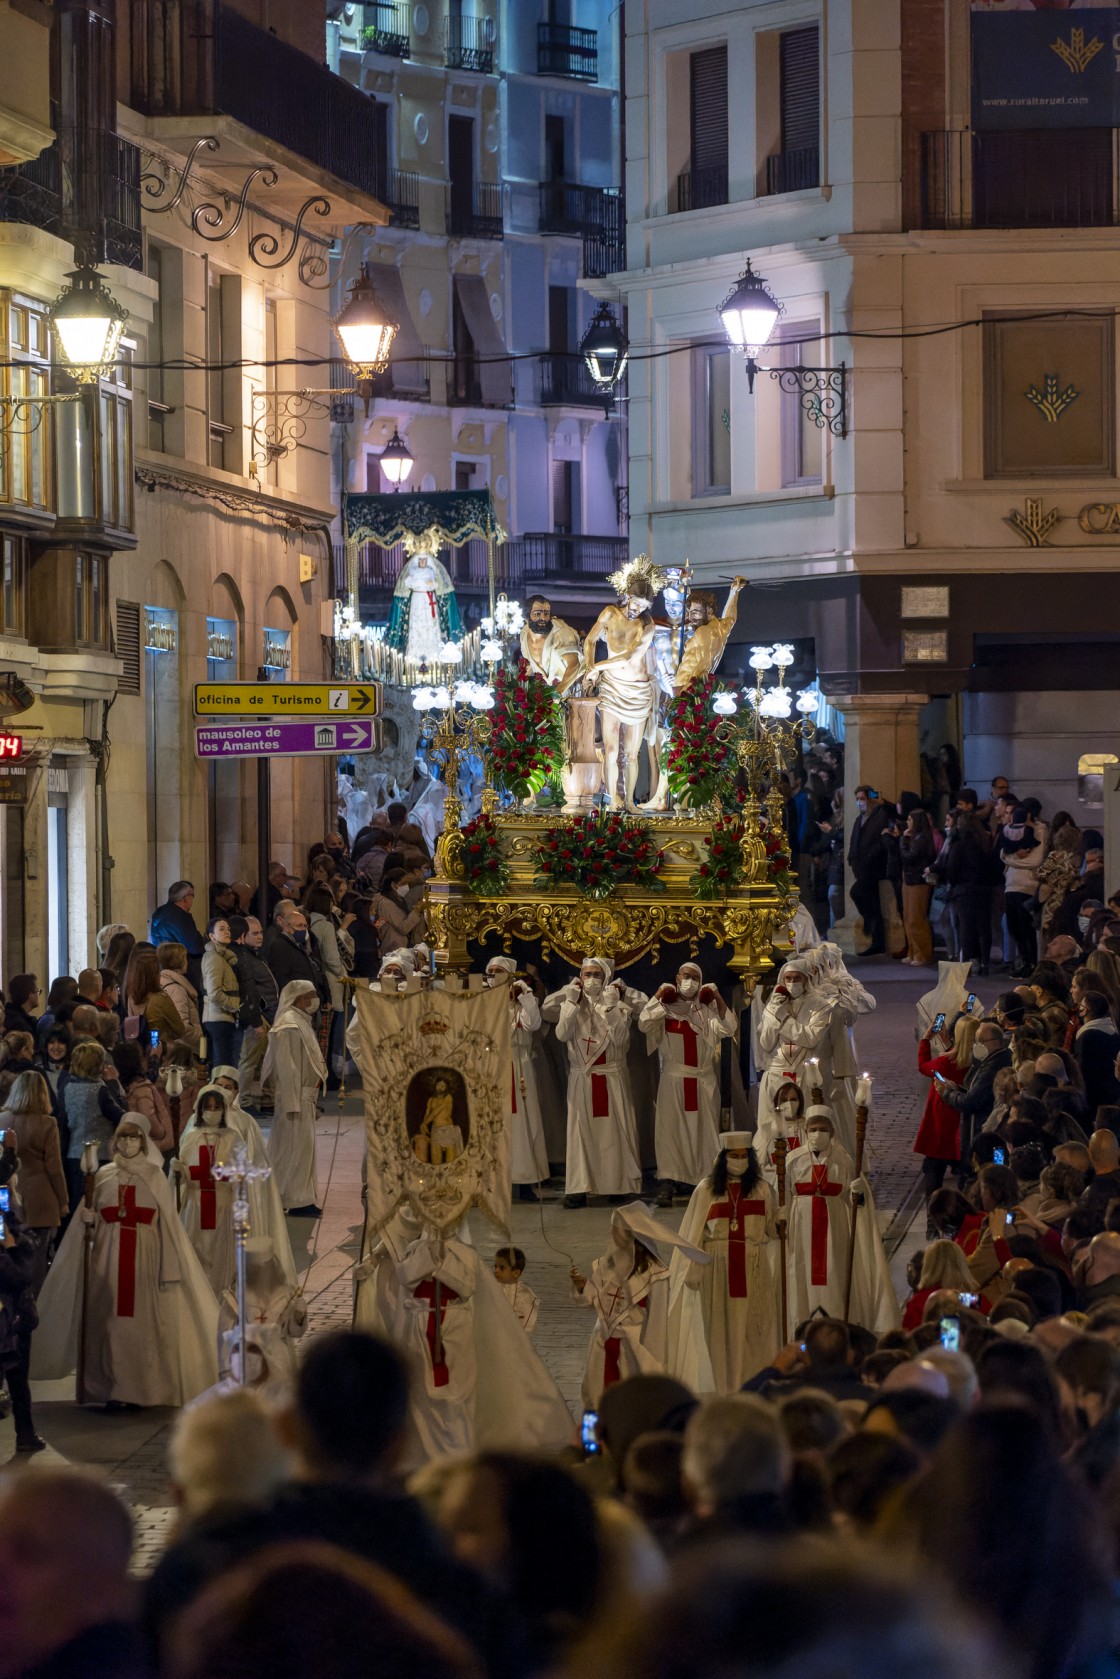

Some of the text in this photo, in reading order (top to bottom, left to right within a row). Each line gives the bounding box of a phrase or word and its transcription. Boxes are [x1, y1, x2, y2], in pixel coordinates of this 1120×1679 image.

[199, 694, 322, 705] oficina de Turismo
[199, 727, 281, 740] mausoleo de
[199, 739, 280, 752] los Amantes
